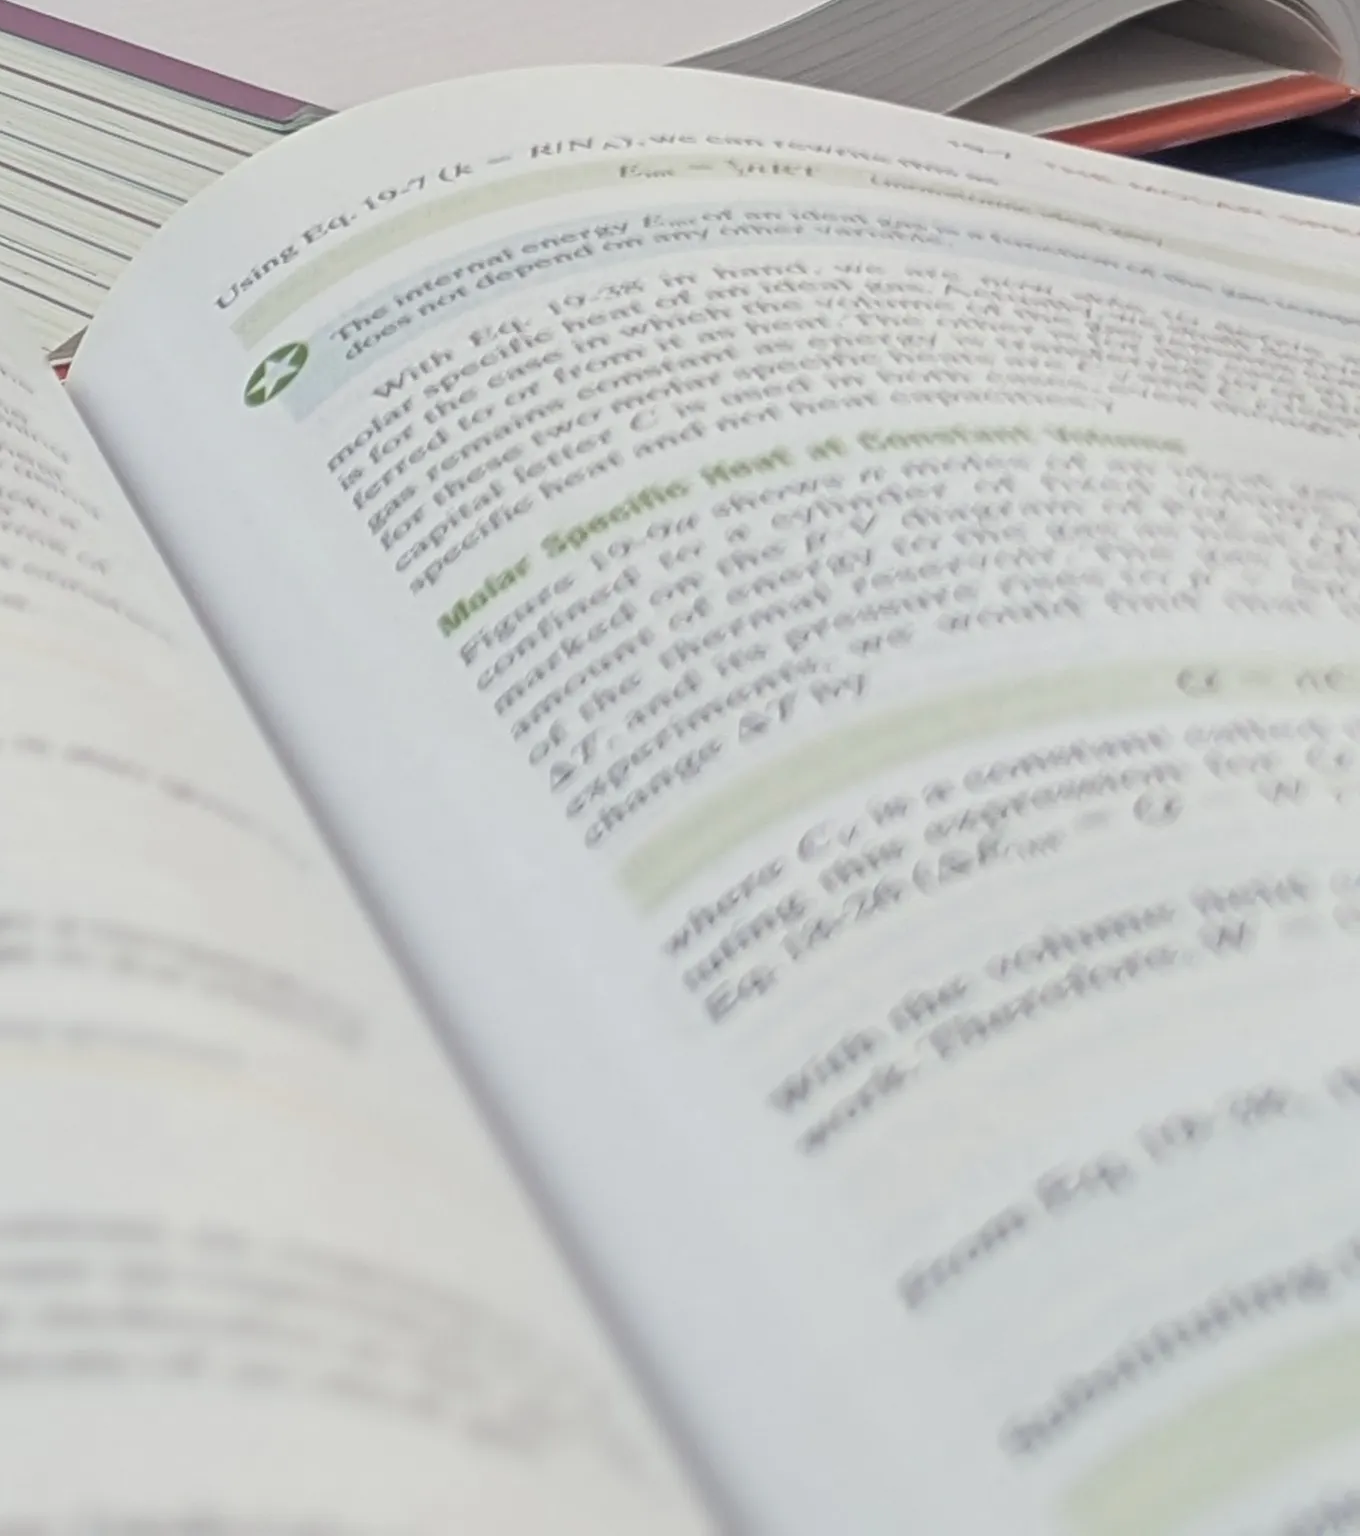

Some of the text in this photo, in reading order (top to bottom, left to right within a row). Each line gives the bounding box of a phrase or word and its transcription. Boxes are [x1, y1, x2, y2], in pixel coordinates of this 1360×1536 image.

[214, 243, 300, 310] Using
[301, 213, 358, 245] Eq.
[706, 135, 765, 148] can
[330, 219, 629, 343] The internal energy
[345, 227, 710, 360] does not depend on any
[327, 329, 555, 473] molar specific
[368, 349, 564, 465] for case
[373, 348, 454, 399] With
[352, 427, 450, 511] ferred
[367, 398, 567, 536] gas remains
[394, 427, 613, 573] capital letter
[432, 443, 526, 507] these
[409, 495, 535, 597] specific
[436, 553, 532, 638] Molar
[540, 477, 690, 560] Specific
[459, 575, 577, 666] Figure
[584, 737, 726, 849] change
